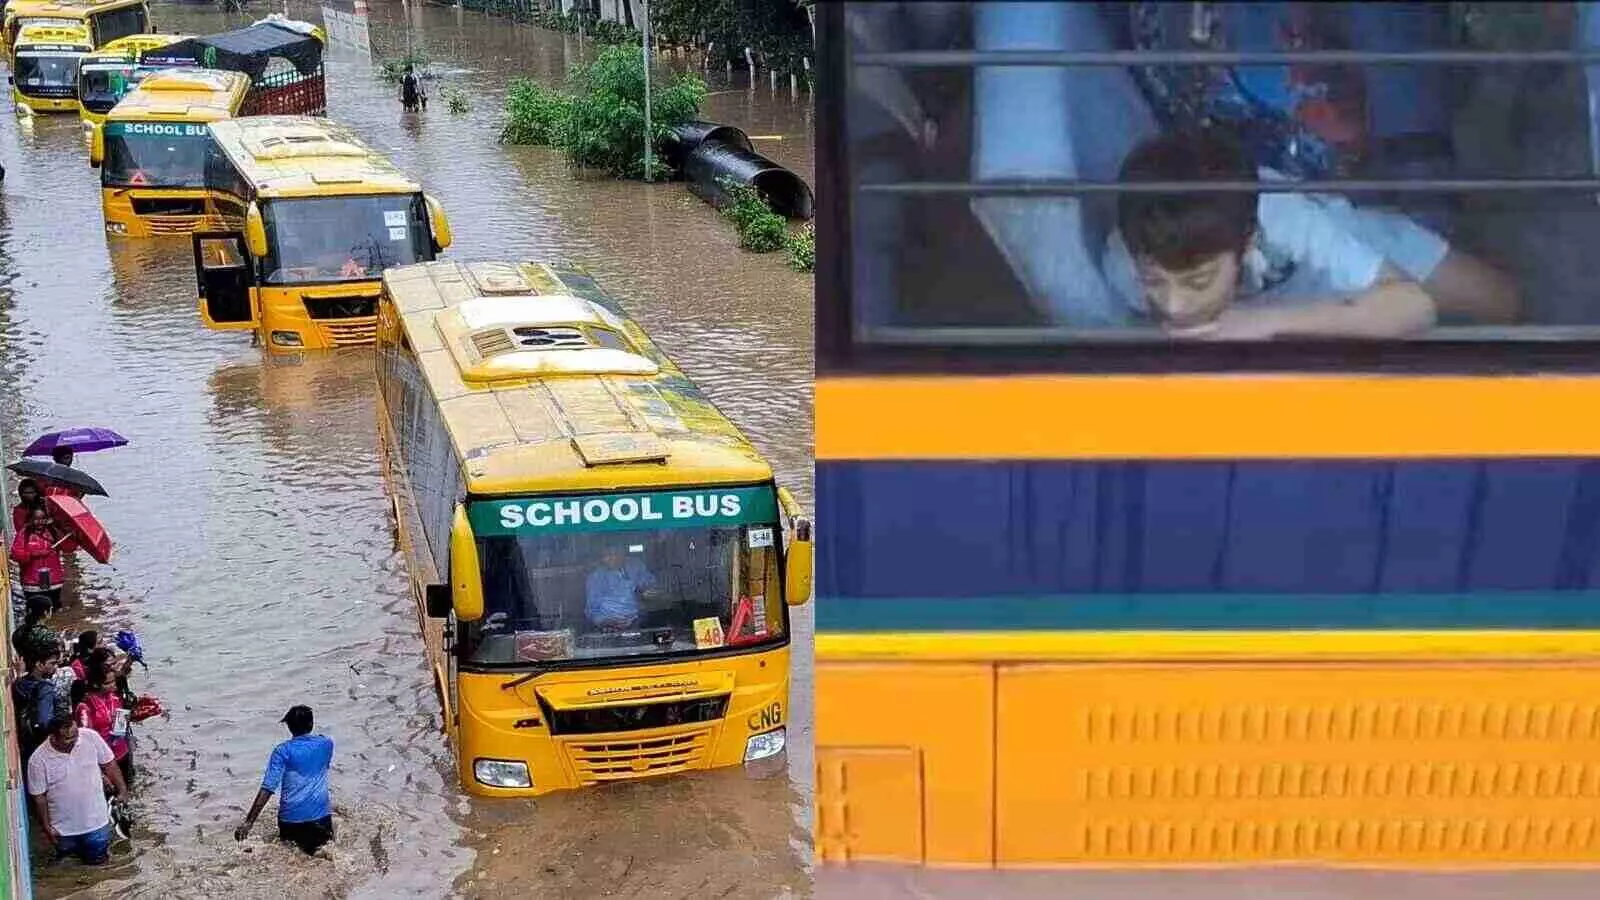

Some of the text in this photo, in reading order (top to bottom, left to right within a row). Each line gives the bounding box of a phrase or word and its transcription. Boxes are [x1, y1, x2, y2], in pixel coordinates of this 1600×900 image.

[124, 123, 210, 136] SCHOOL BU
[500, 494, 741, 528] SCHOOL BUS
[747, 702, 782, 730] CNG
